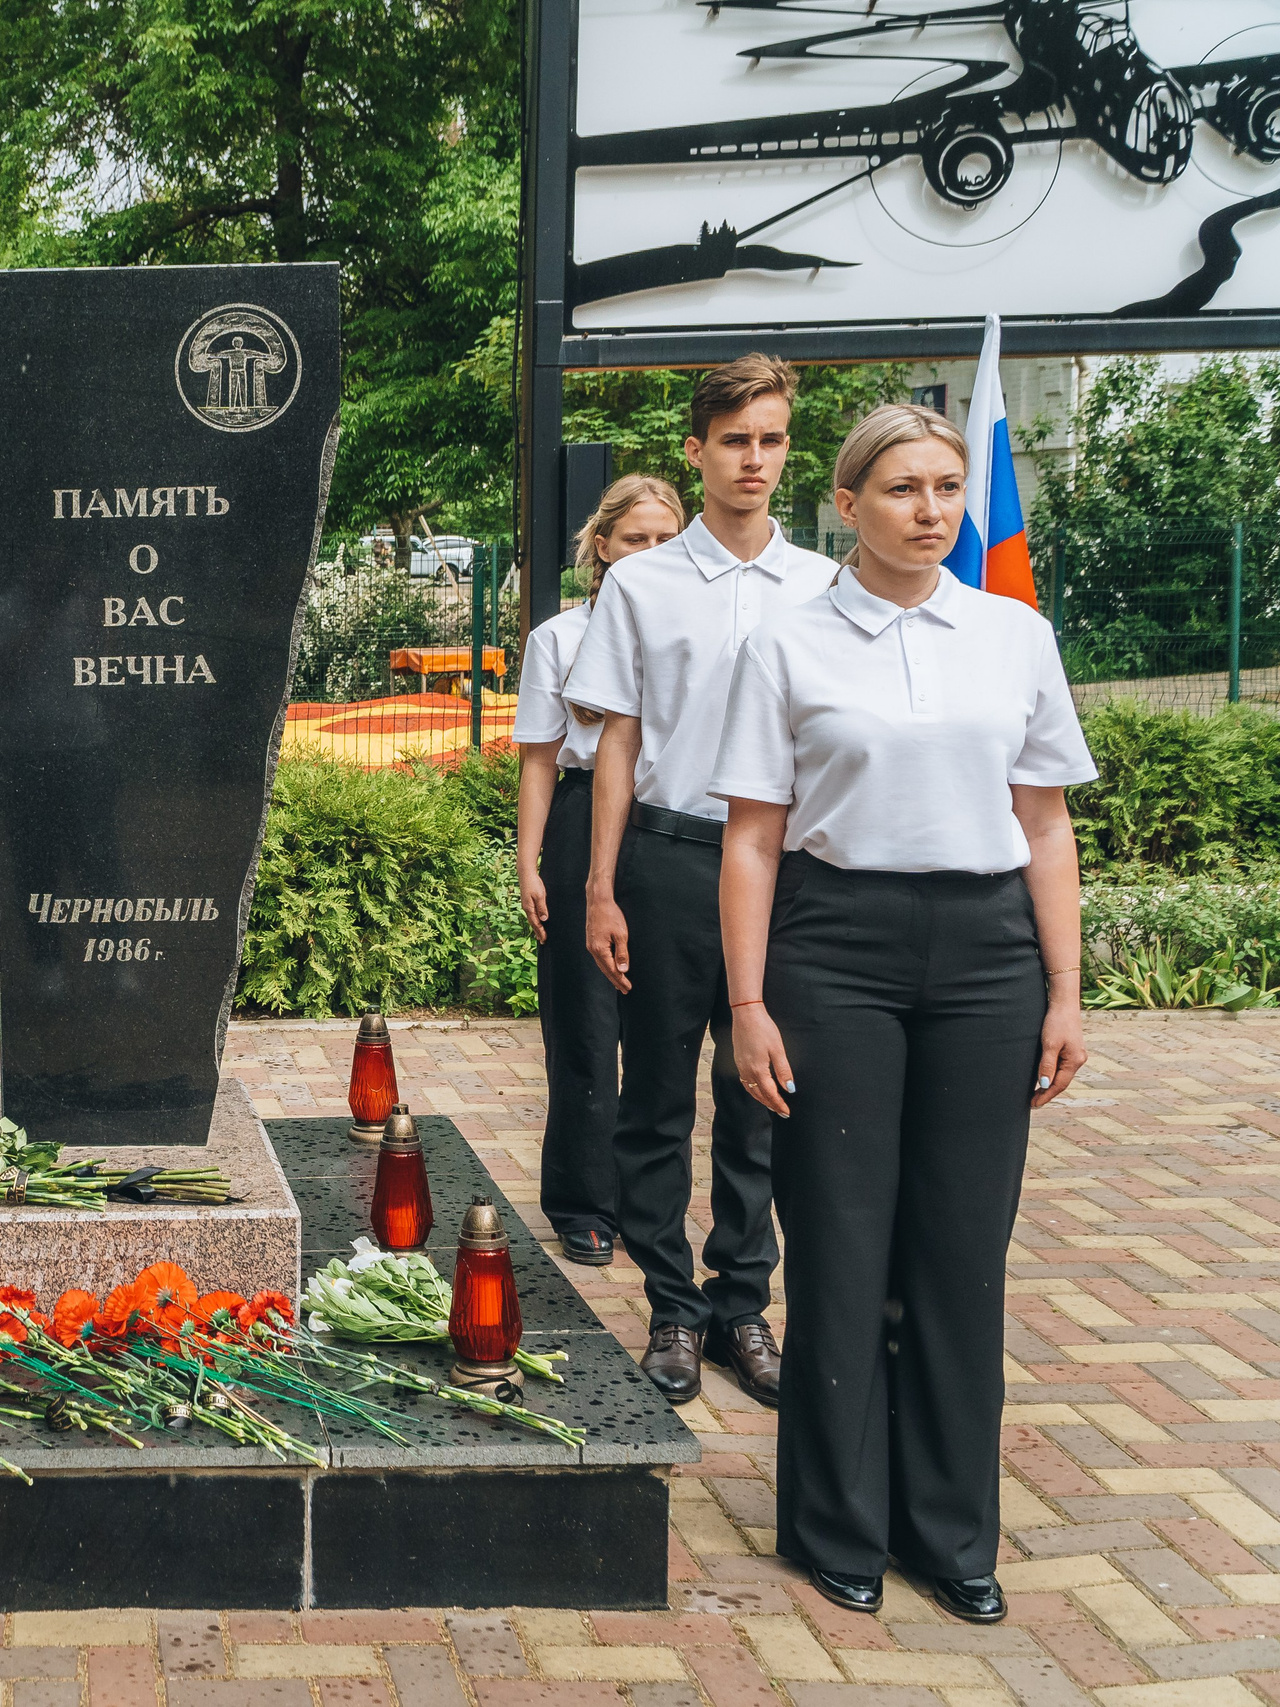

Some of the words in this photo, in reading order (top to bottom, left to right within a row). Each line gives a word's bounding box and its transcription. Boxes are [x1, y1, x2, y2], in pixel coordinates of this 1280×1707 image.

[54, 486, 229, 518] ПАМЯТЬ
[129, 544, 158, 574] О
[104, 596, 184, 626] ВАС
[74, 655, 216, 686] ВЕЧНА
[29, 894, 219, 923] ЧЕРНОБЫЛЬ
[84, 939, 151, 961] 1986
